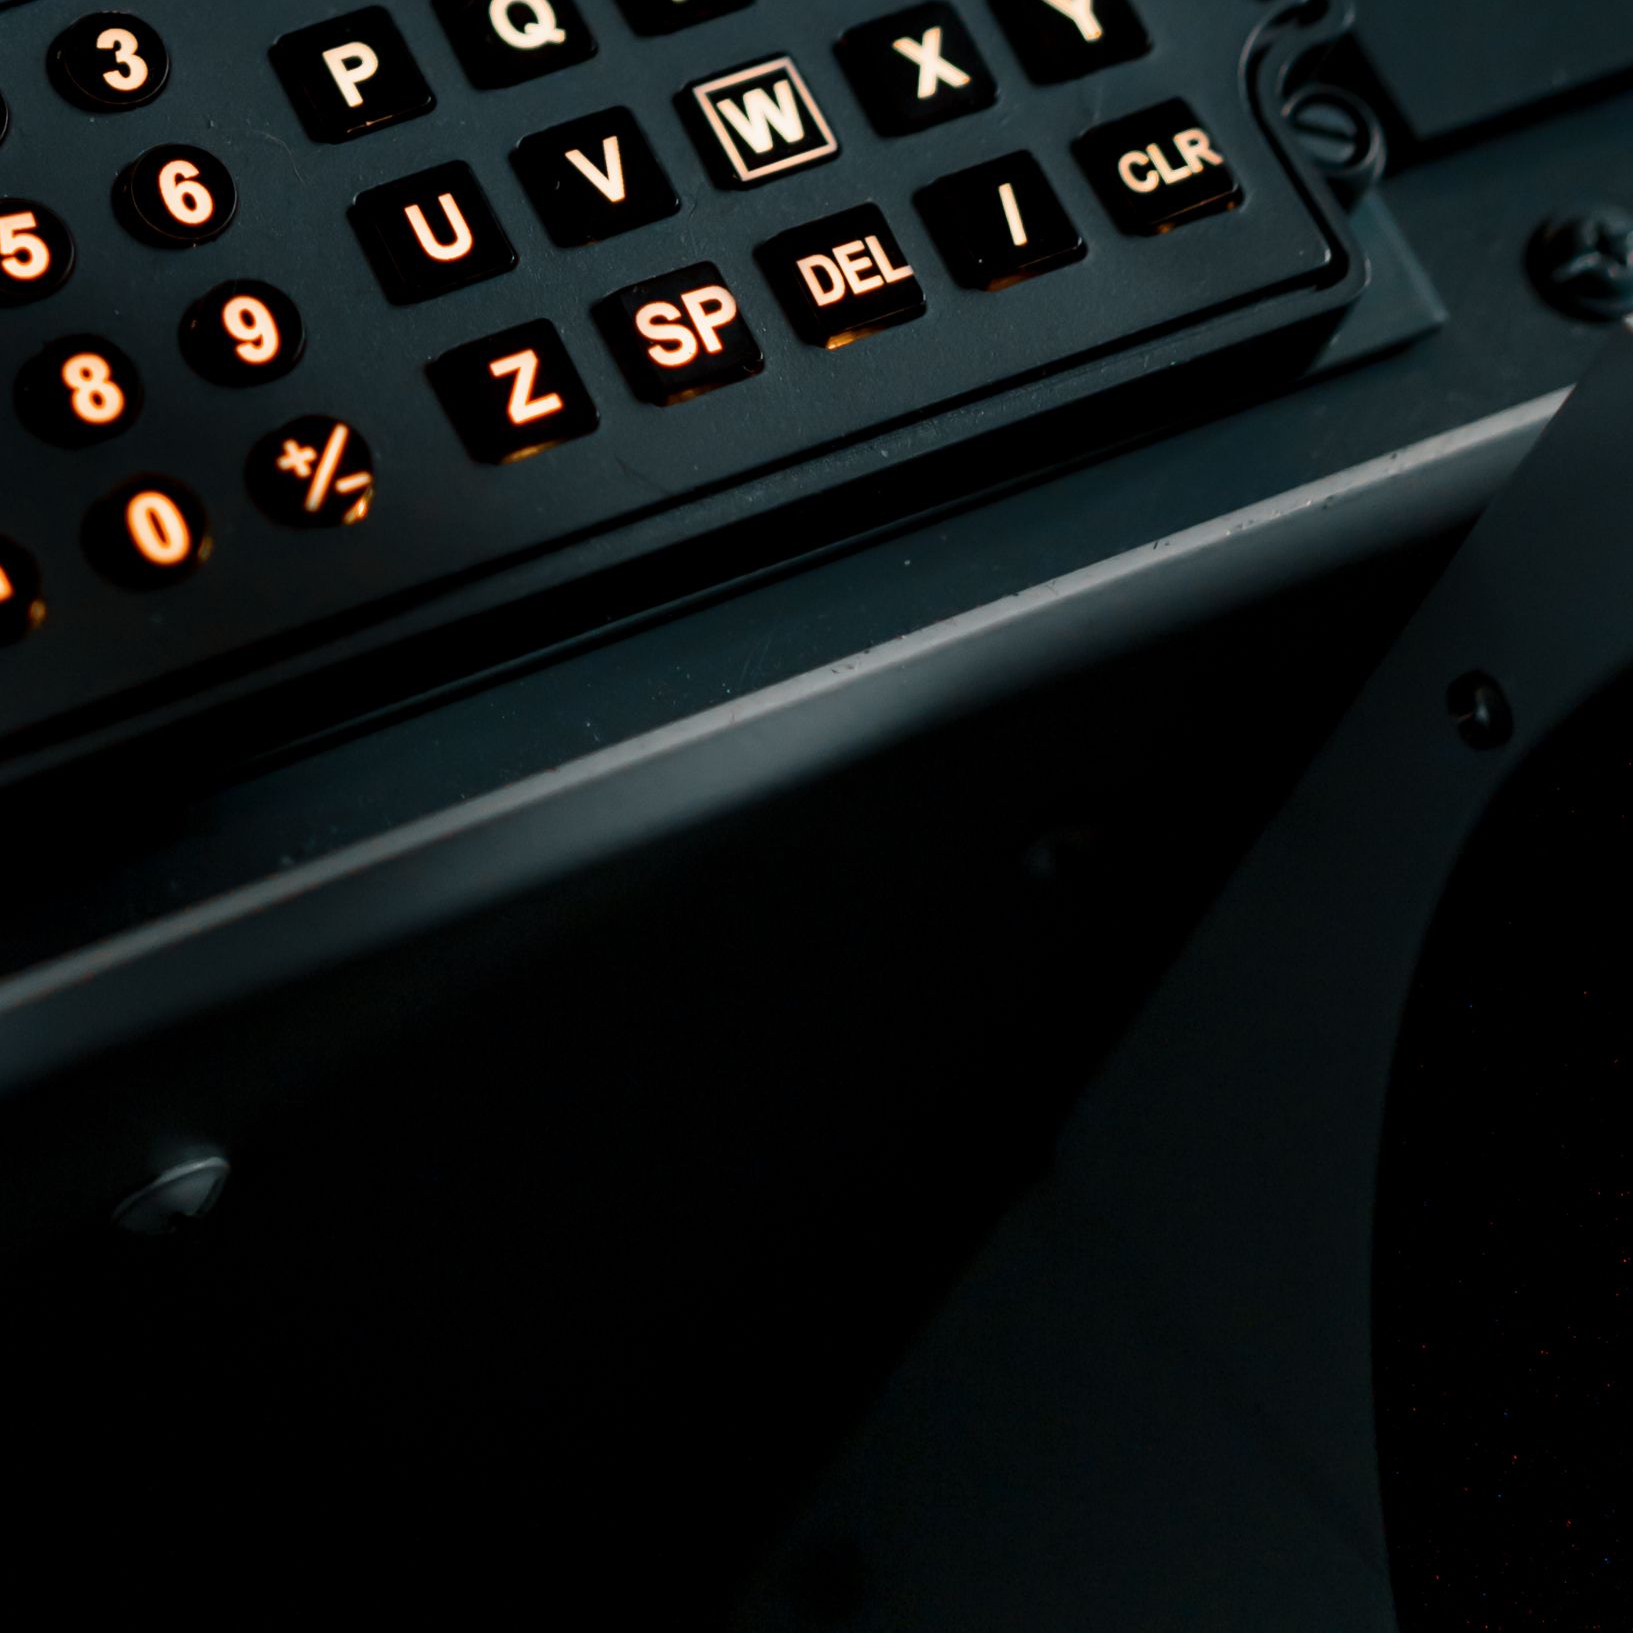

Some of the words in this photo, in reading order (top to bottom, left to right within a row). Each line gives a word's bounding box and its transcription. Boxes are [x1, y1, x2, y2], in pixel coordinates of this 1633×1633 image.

[97, 29, 148, 91] 3
[323, 42, 378, 107] P
[893, 28, 970, 98] X
[720, 85, 804, 158] W
[158, 160, 214, 225] 6
[565, 136, 625, 202] V
[1119, 129, 1223, 192] CLR
[405, 193, 473, 262] U
[797, 236, 913, 306] DEL
[222, 295, 280, 364] 9
[636, 285, 736, 367] SP
[62, 353, 124, 424] 8
[489, 349, 563, 425] Z
[127, 491, 190, 564] 0
